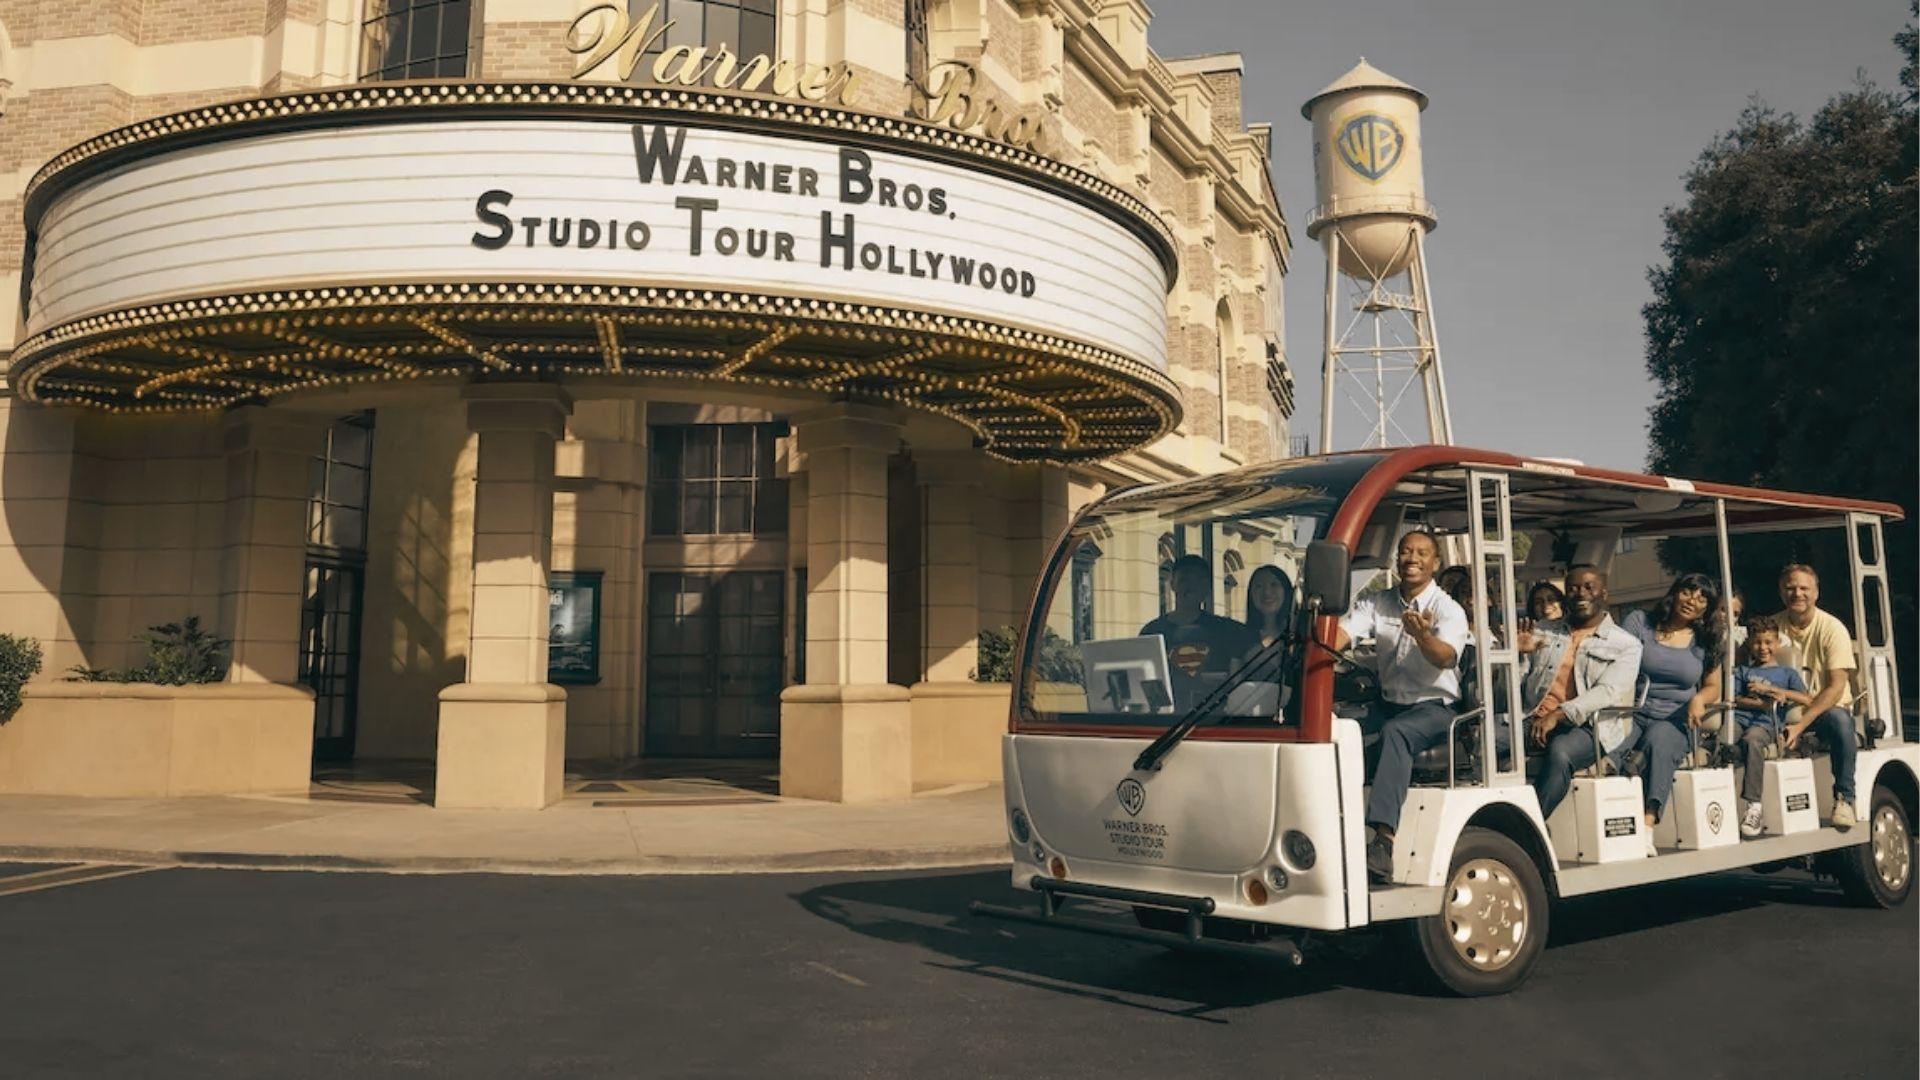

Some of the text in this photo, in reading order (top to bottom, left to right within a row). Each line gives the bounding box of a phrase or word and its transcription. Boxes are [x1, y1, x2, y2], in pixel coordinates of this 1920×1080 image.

[566, 3, 860, 106] Warner
[632, 124, 956, 220] WARNER BROS.
[1339, 120, 1399, 175] WB
[471, 189, 1036, 298] STUDIO TOUR HOLLYWOOD
[1119, 783, 1143, 813] WB
[1103, 819, 1140, 833] WARNER
[1110, 832, 1167, 849] STUDIO TOUR
